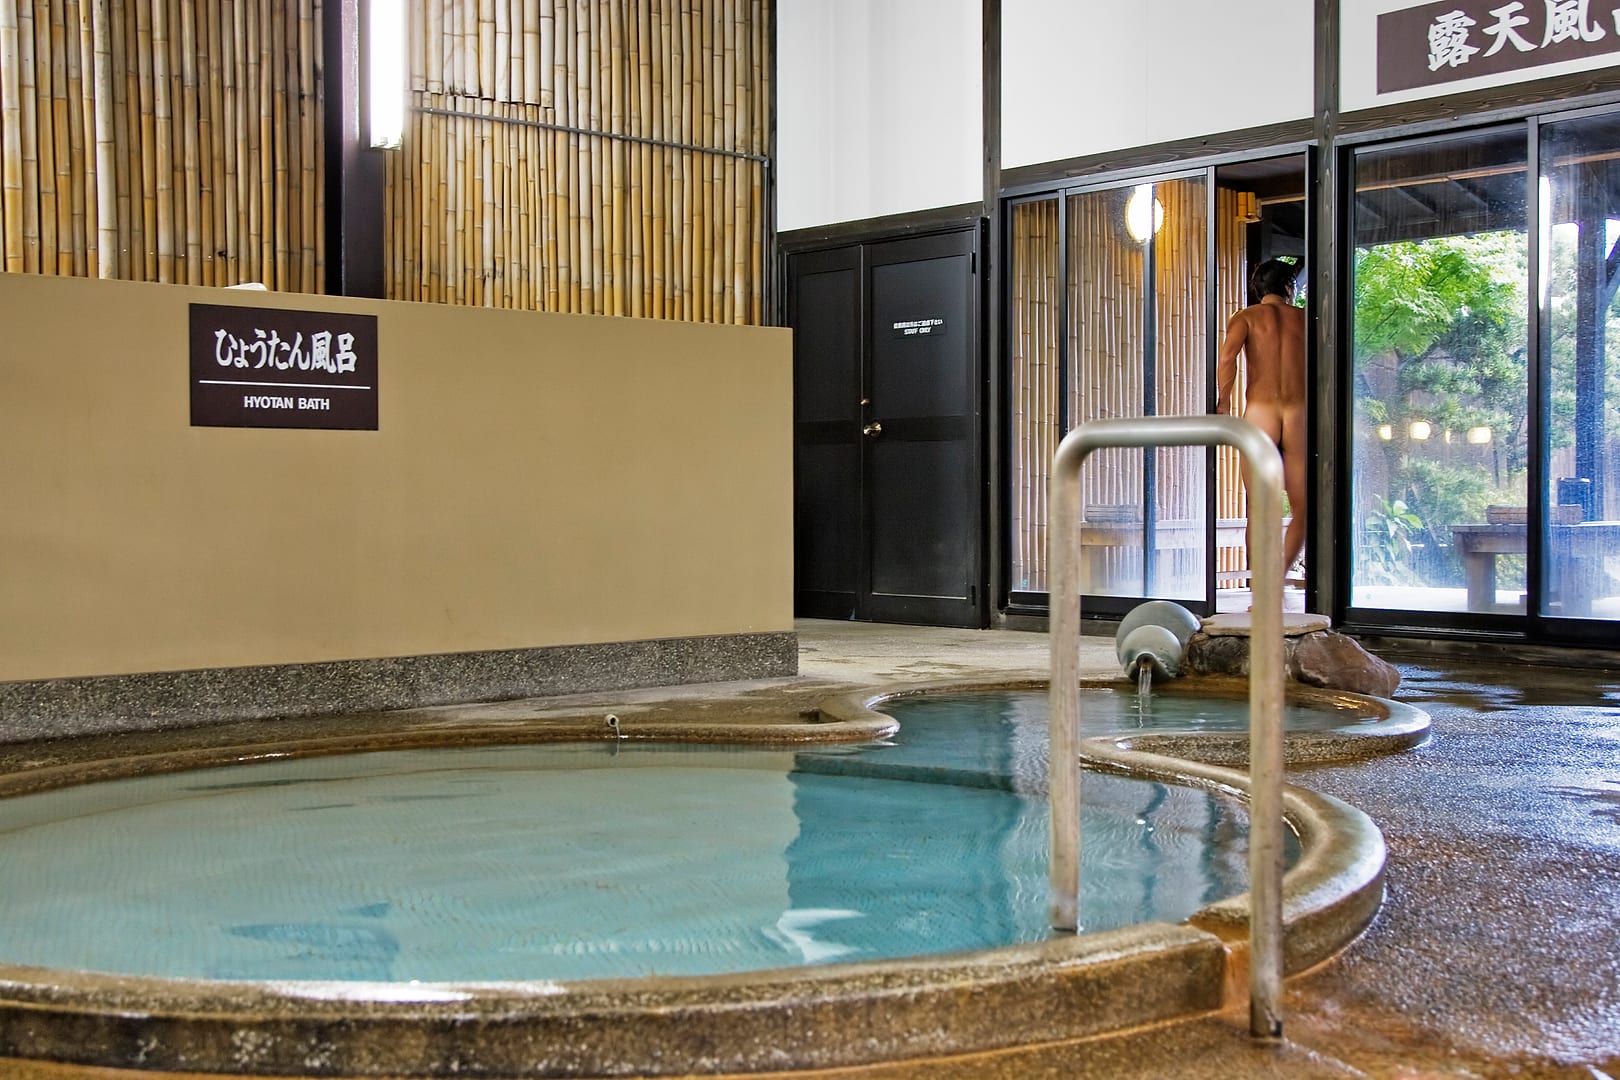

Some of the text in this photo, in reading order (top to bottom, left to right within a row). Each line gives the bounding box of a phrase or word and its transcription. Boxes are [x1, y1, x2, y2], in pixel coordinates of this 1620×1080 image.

[1427, 0, 1620, 72] 露天風
[214, 328, 358, 374] ひょうたん風呂
[244, 396, 330, 411] HYOTAN BATH
